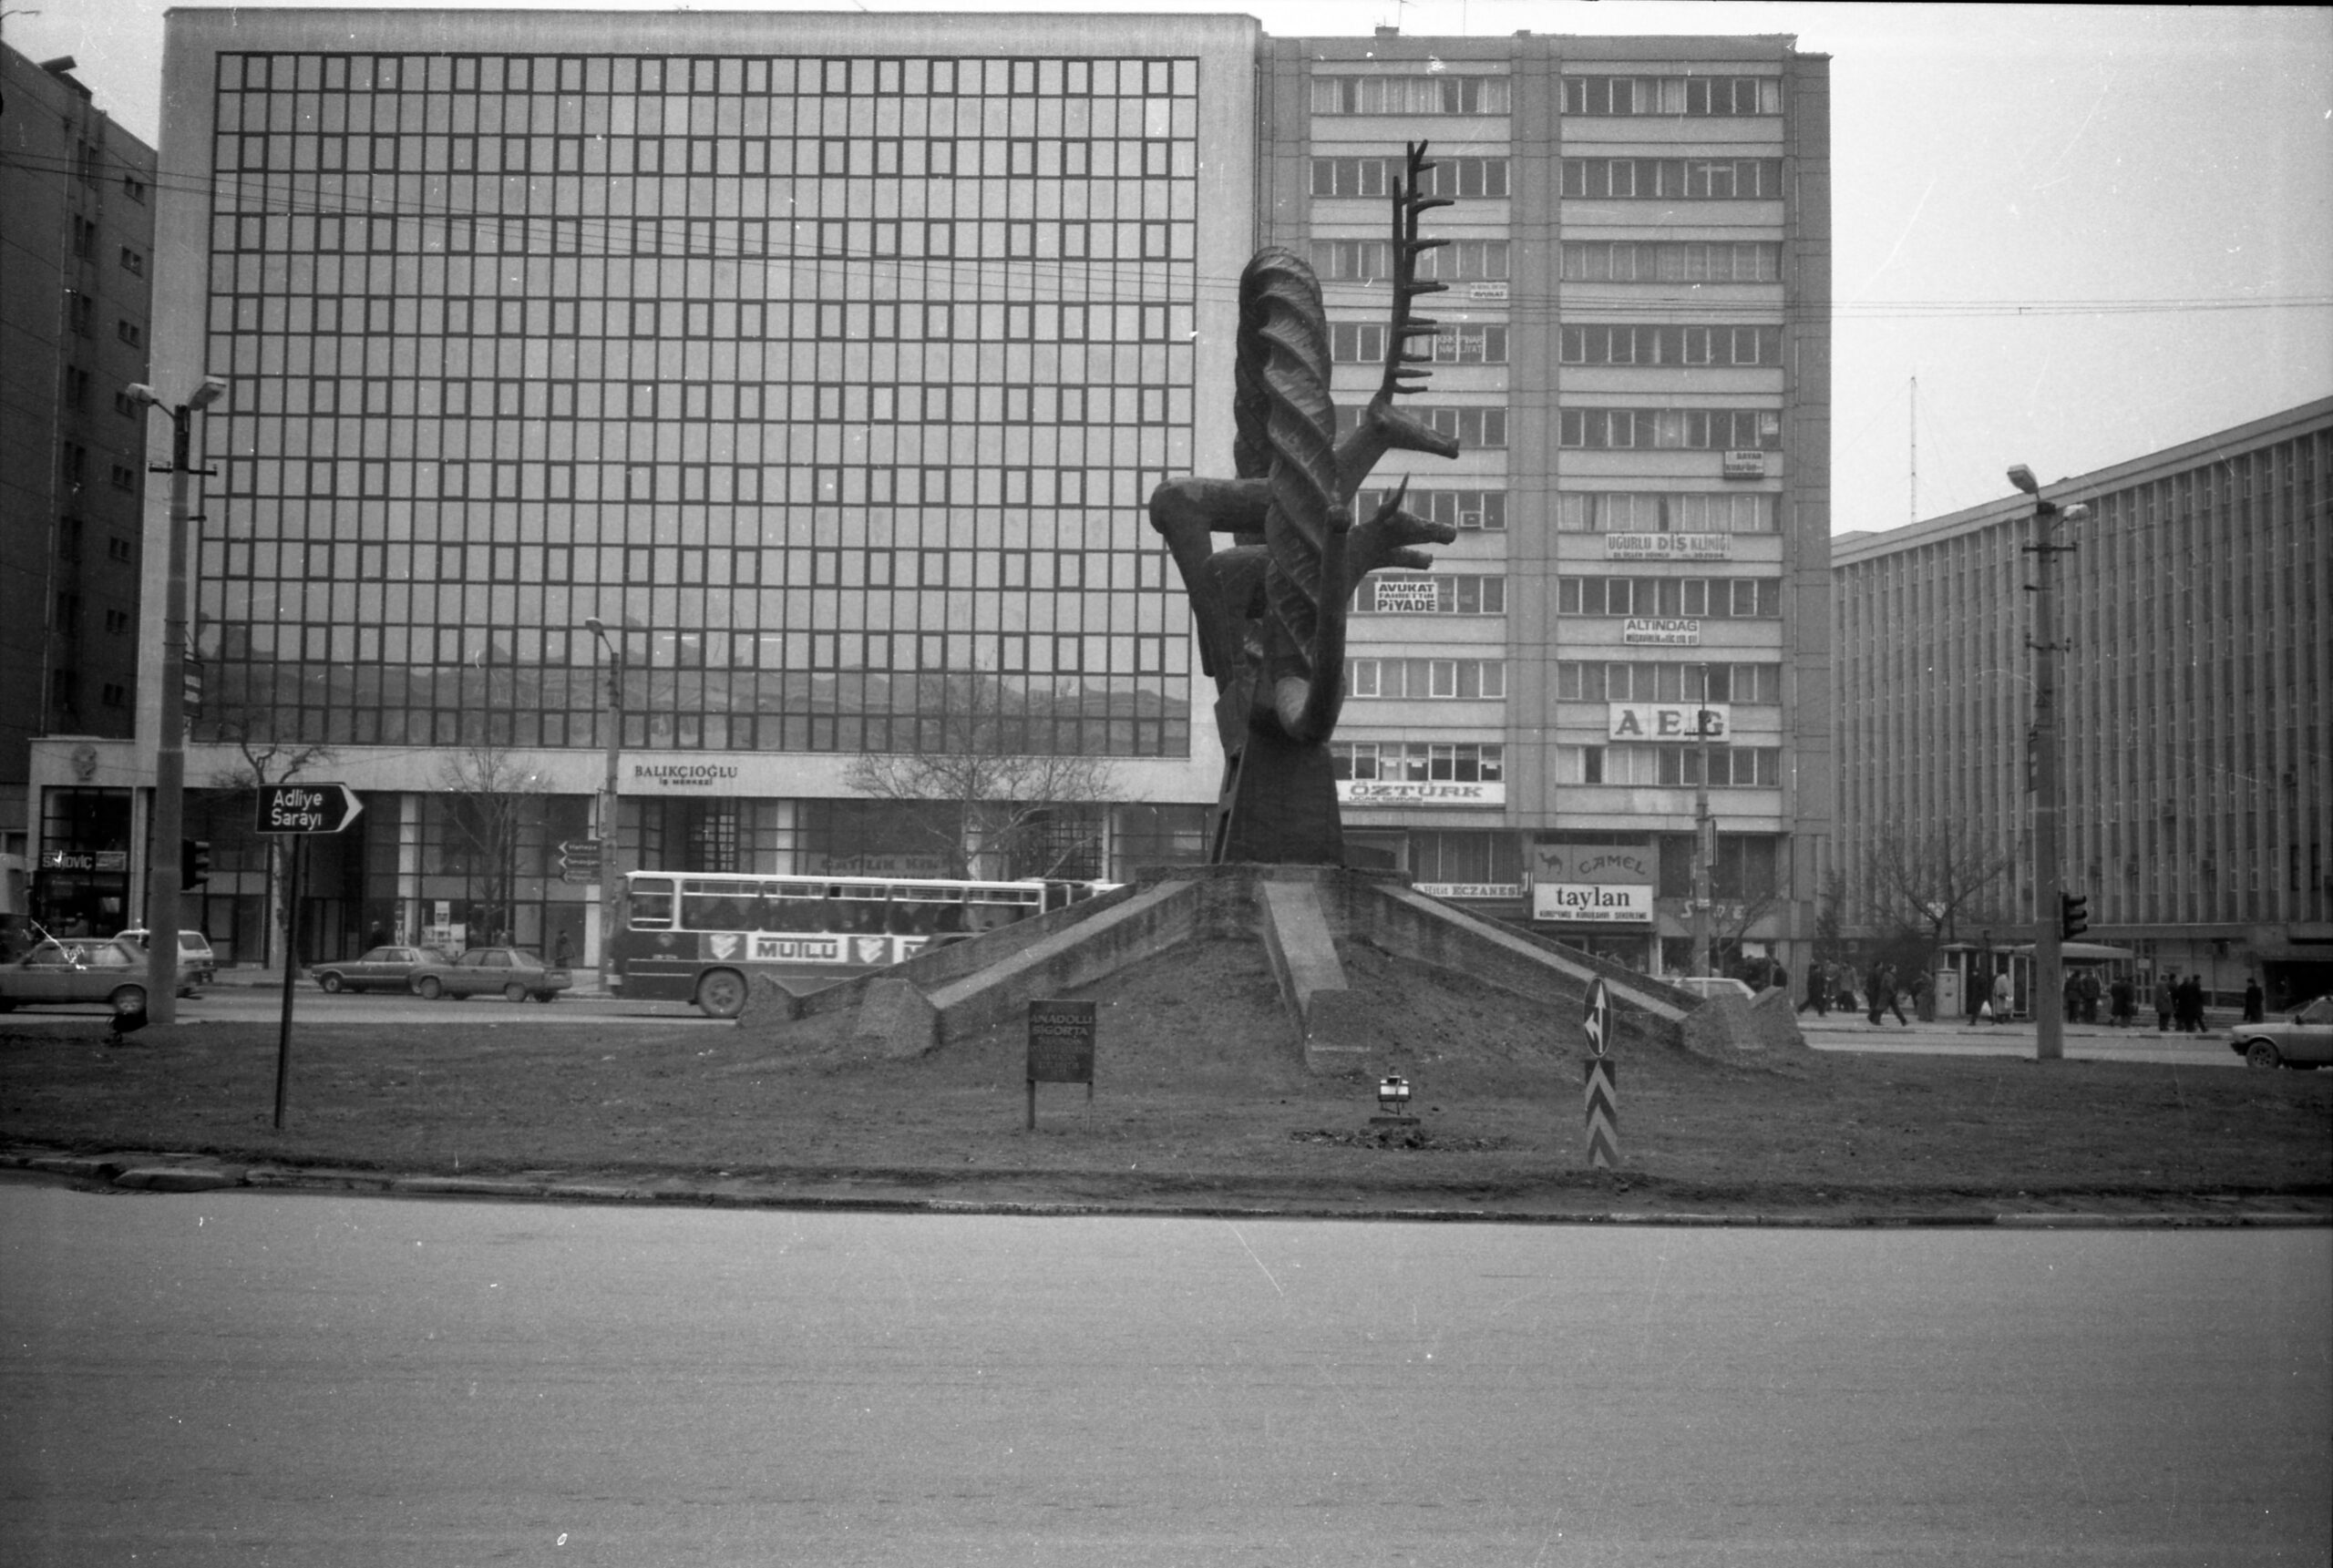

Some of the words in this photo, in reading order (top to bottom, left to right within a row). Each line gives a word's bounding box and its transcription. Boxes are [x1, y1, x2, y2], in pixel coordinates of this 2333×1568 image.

[1658, 534, 1687, 552] DİŞ
[1379, 583, 1434, 593] AVUKAT
[1615, 710, 1724, 735] AEG
[272, 789, 324, 811] Adliye
[1350, 782, 1484, 798] ÖZTÜRK
[271, 807, 323, 831] Sarayı
[1578, 855, 1646, 876] CAMEL
[1556, 886, 1629, 910] taylan
[757, 937, 837, 958] MUTLU
